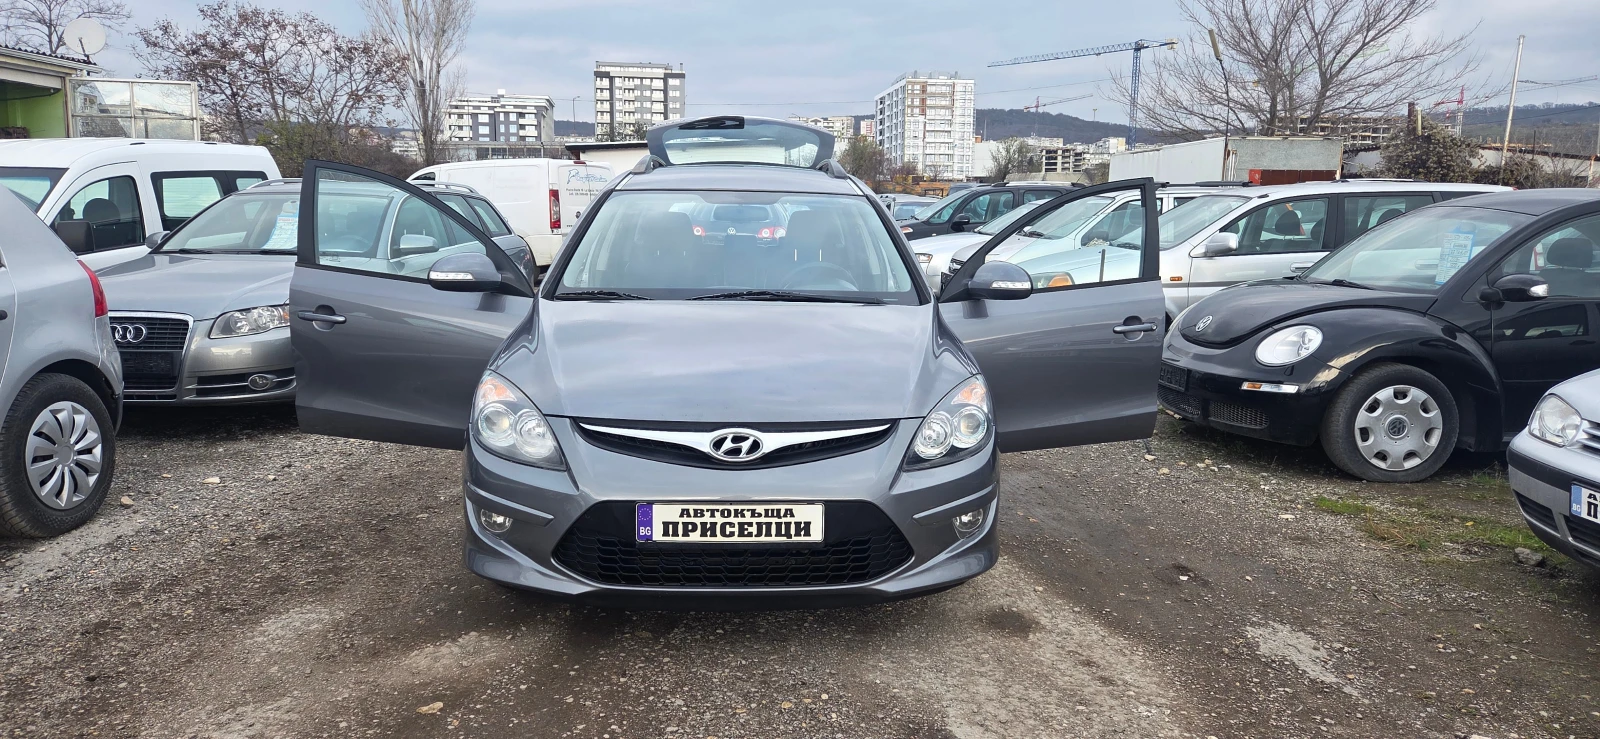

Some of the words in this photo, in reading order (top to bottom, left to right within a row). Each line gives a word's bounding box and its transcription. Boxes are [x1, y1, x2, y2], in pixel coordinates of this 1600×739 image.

[1572, 503, 1581, 512] BG
[679, 508, 795, 519] АВТОКЪЩА
[639, 526, 652, 536] BG
[662, 521, 812, 539] ПРИСЕЛЦИ
